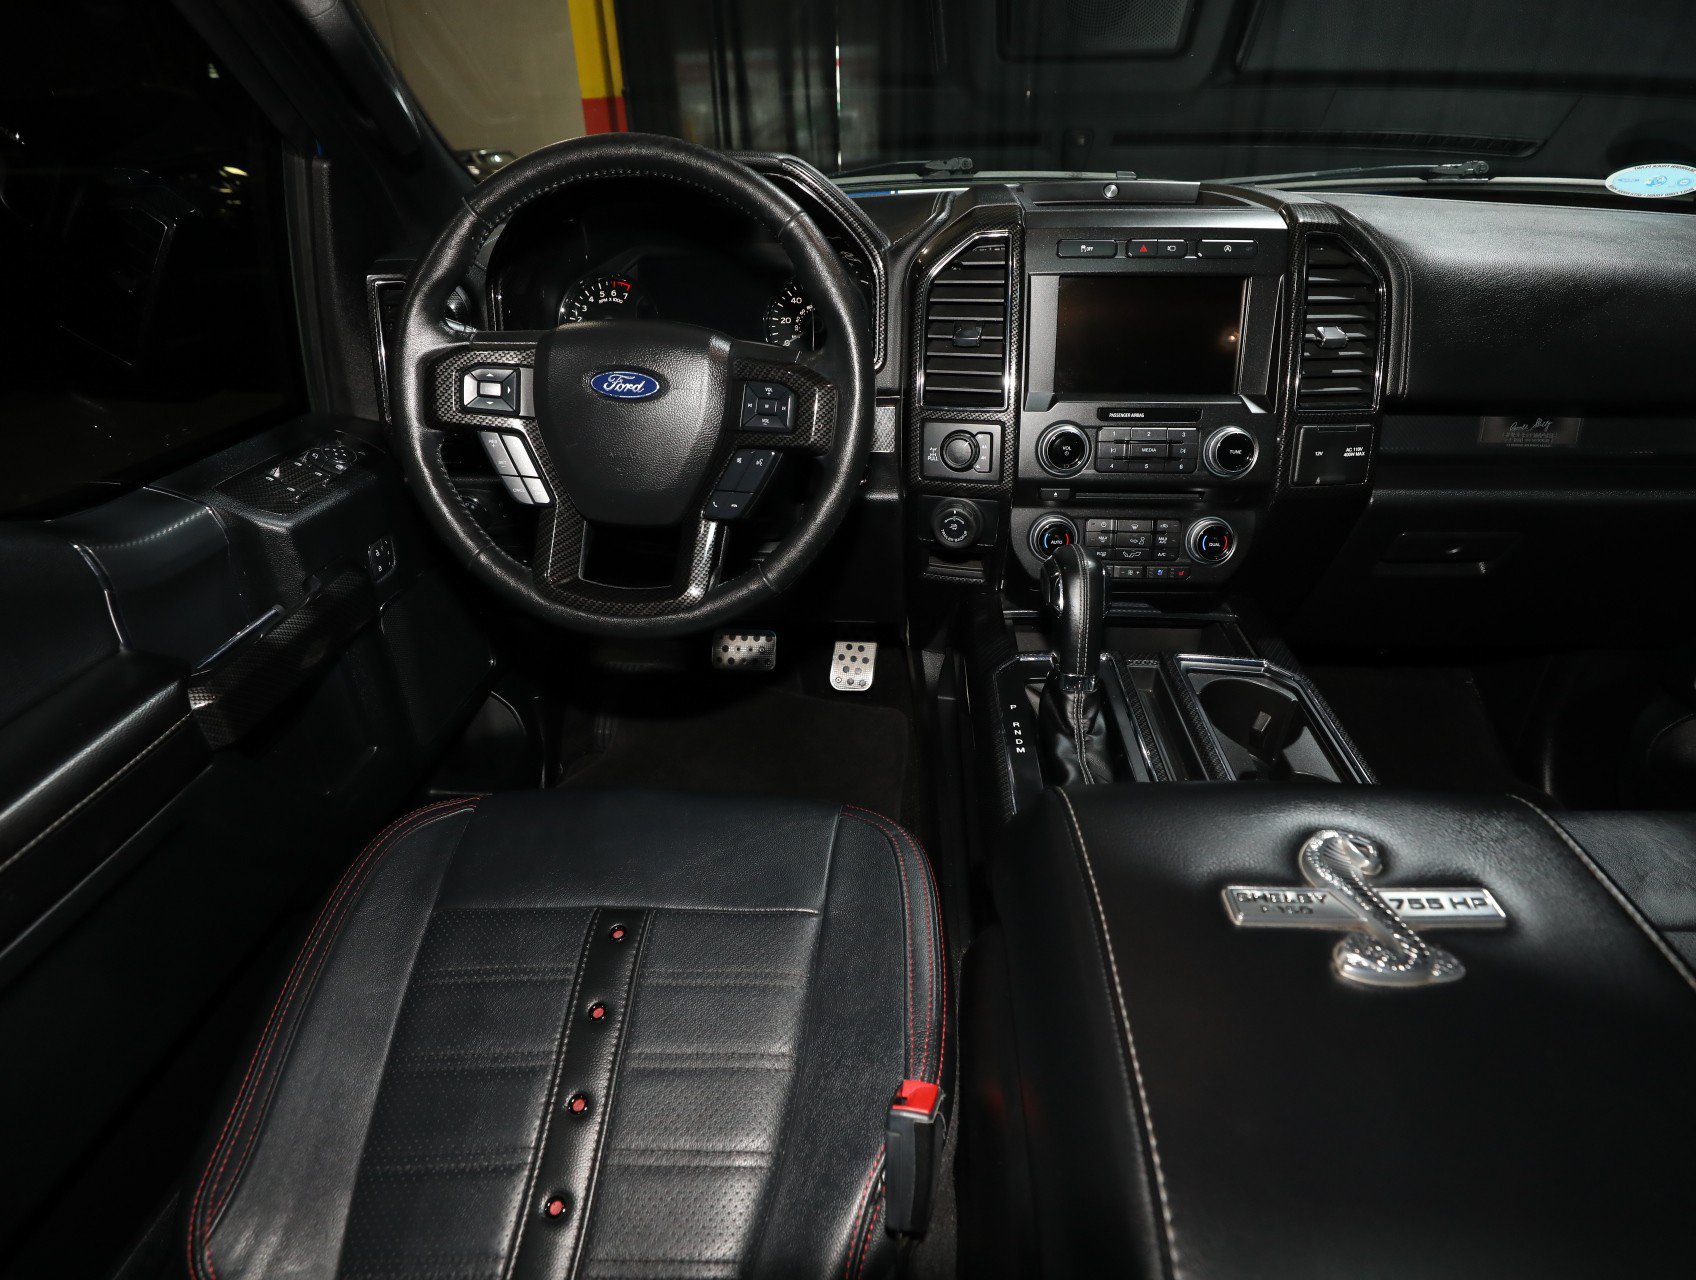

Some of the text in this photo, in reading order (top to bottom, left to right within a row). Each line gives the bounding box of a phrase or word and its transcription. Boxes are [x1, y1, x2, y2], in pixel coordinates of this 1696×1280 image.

[600, 290, 605, 298] 5
[623, 292, 628, 300] 7
[603, 374, 645, 393] Ford
[1449, 896, 1489, 910] HP
